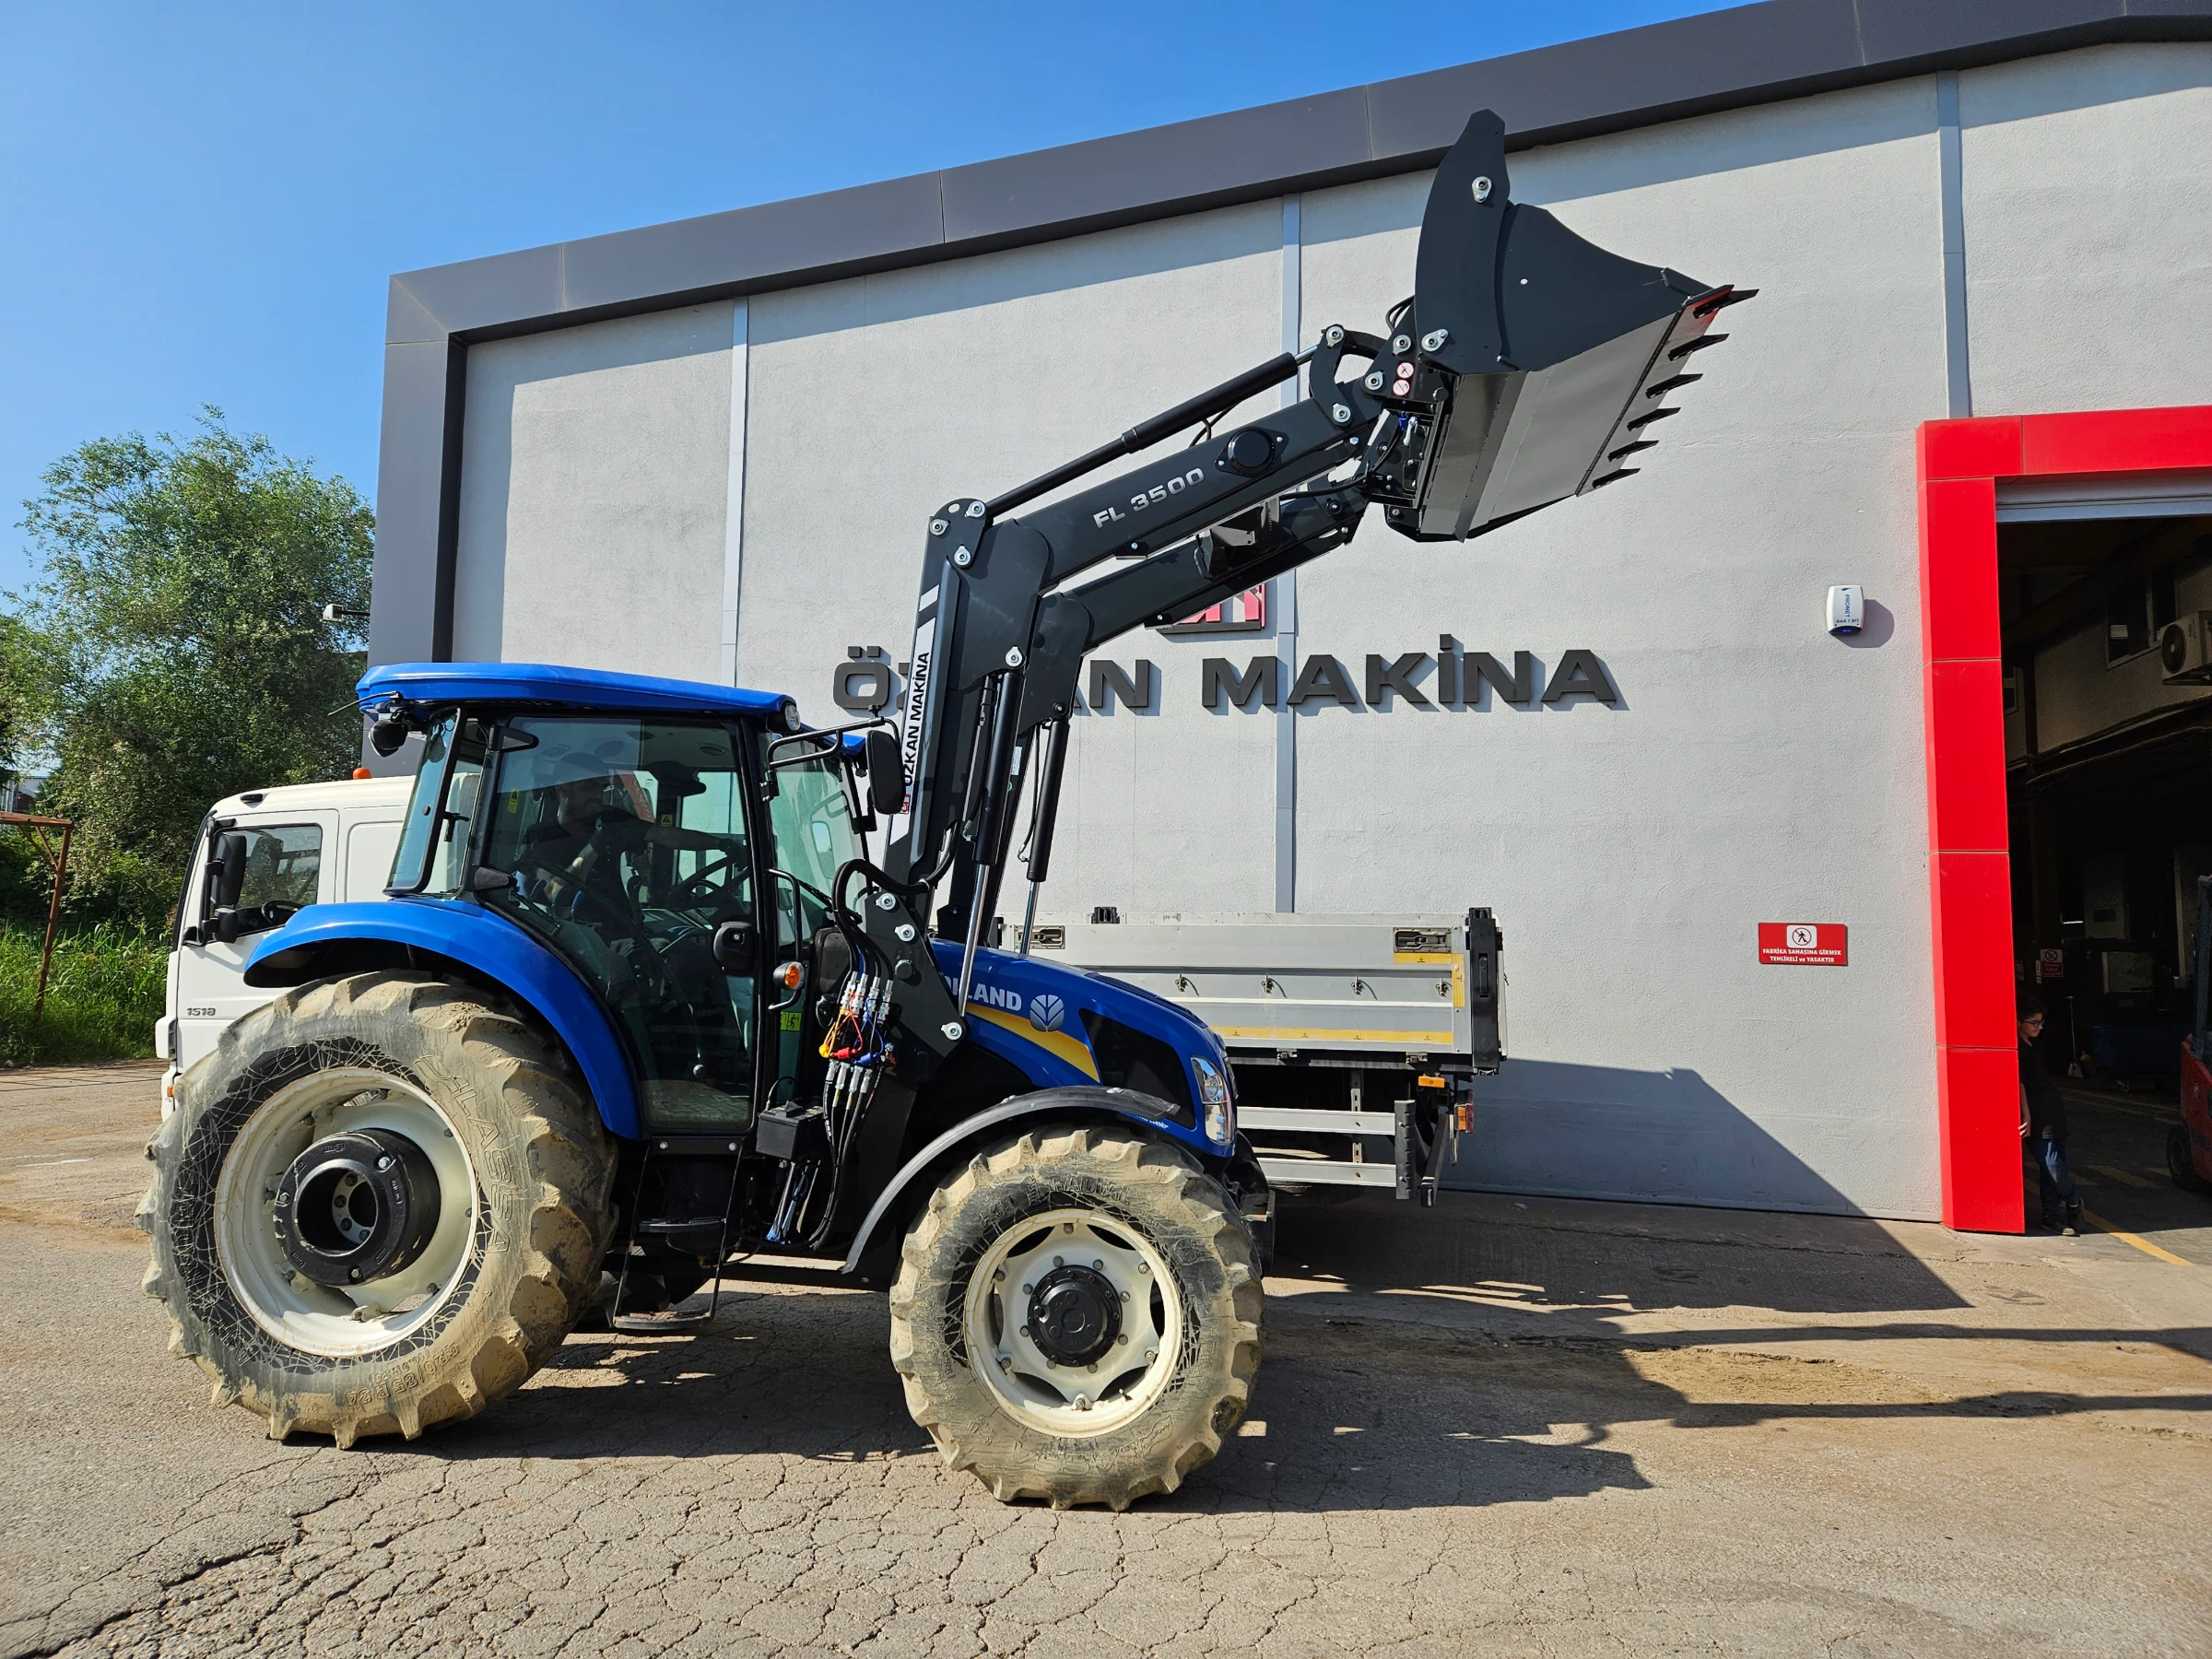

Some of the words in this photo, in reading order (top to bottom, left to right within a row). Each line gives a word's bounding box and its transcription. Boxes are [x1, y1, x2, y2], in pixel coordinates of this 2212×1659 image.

[1093, 506, 1126, 529] FL
[1130, 467, 1205, 512] 3500
[910, 651, 930, 722] MAKİNA
[1202, 633, 1617, 707] MAKİNA
